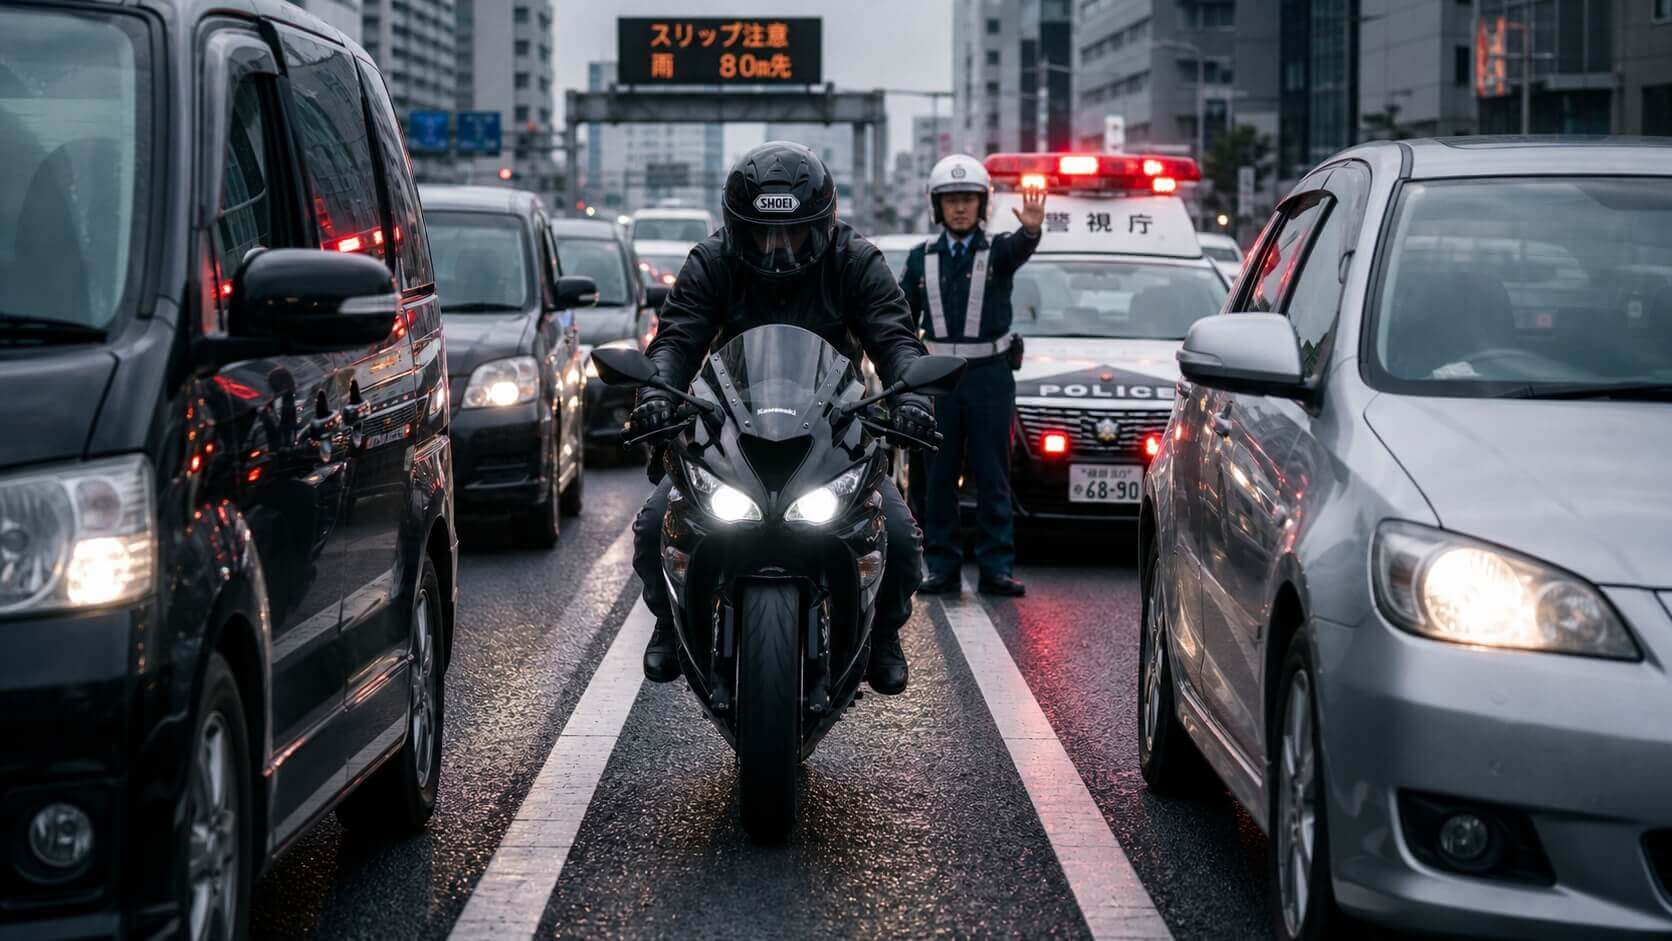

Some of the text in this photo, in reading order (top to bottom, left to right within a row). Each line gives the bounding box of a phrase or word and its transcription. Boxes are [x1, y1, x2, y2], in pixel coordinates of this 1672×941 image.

[650, 22, 788, 48] スリップ注意
[719, 53, 792, 79] 80m先
[760, 197, 793, 209] SHOEI
[1045, 211, 1153, 234] 警視庁
[1040, 384, 1175, 399] POLICE
[1086, 480, 1139, 500] 68-90
